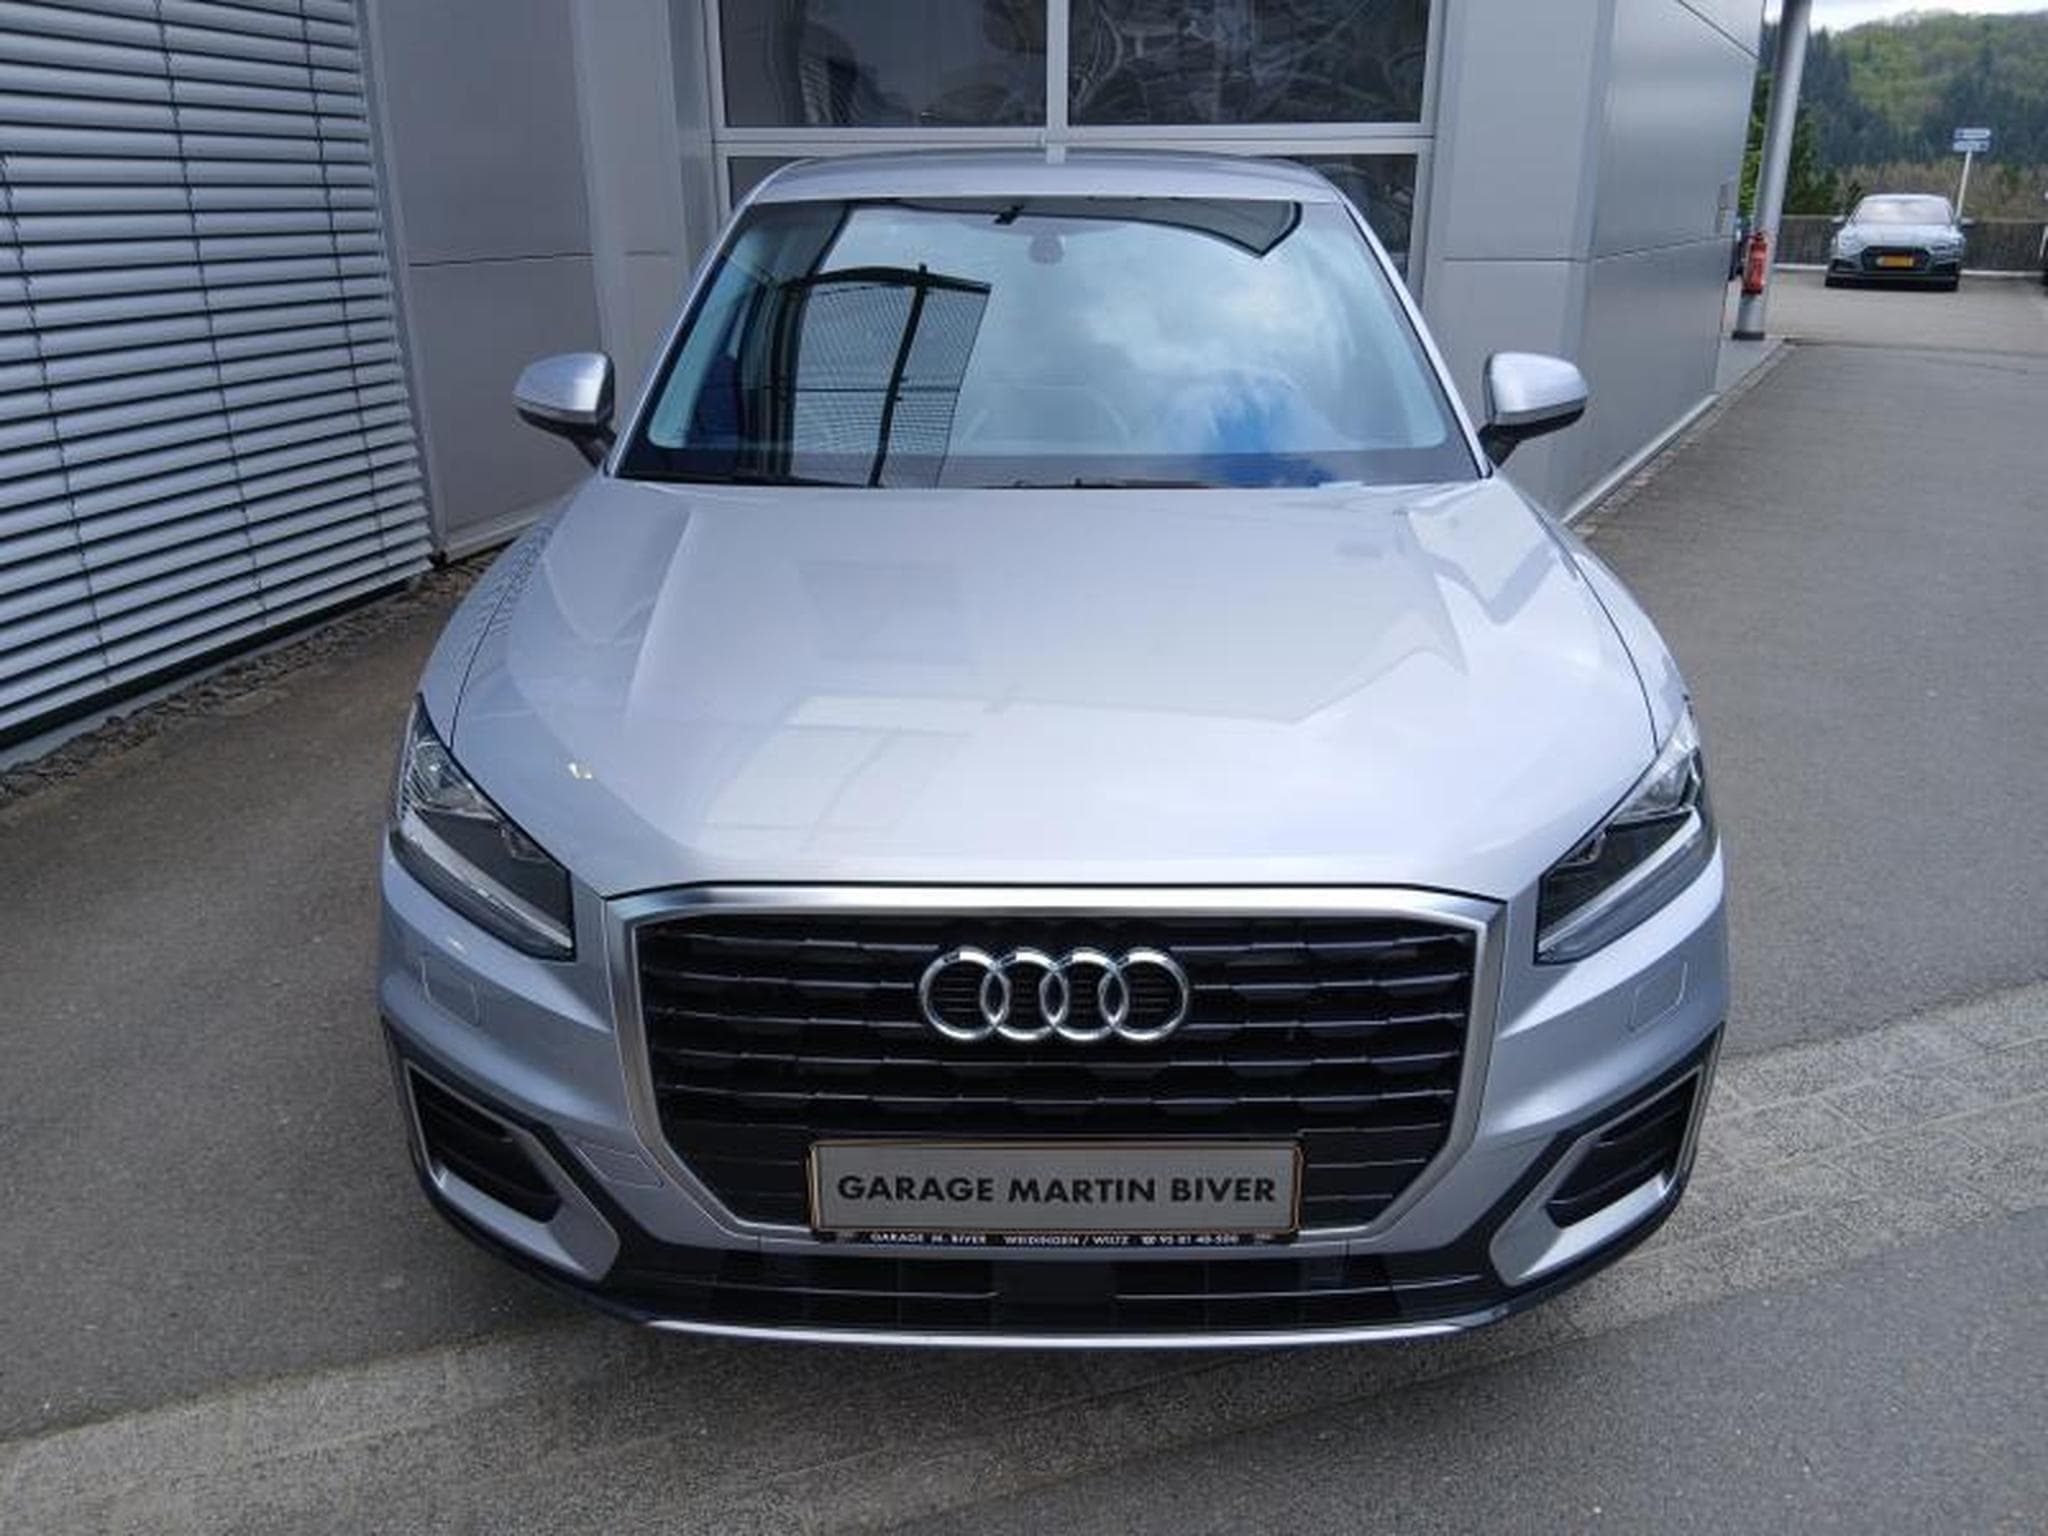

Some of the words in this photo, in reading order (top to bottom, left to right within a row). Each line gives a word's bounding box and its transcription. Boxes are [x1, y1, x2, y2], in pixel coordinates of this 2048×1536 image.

[837, 1175, 994, 1200] GARAGE
[1008, 1178, 1155, 1202] MARTIN
[1170, 1177, 1276, 1201] BIVER
[870, 1233, 924, 1243] GARAGE
